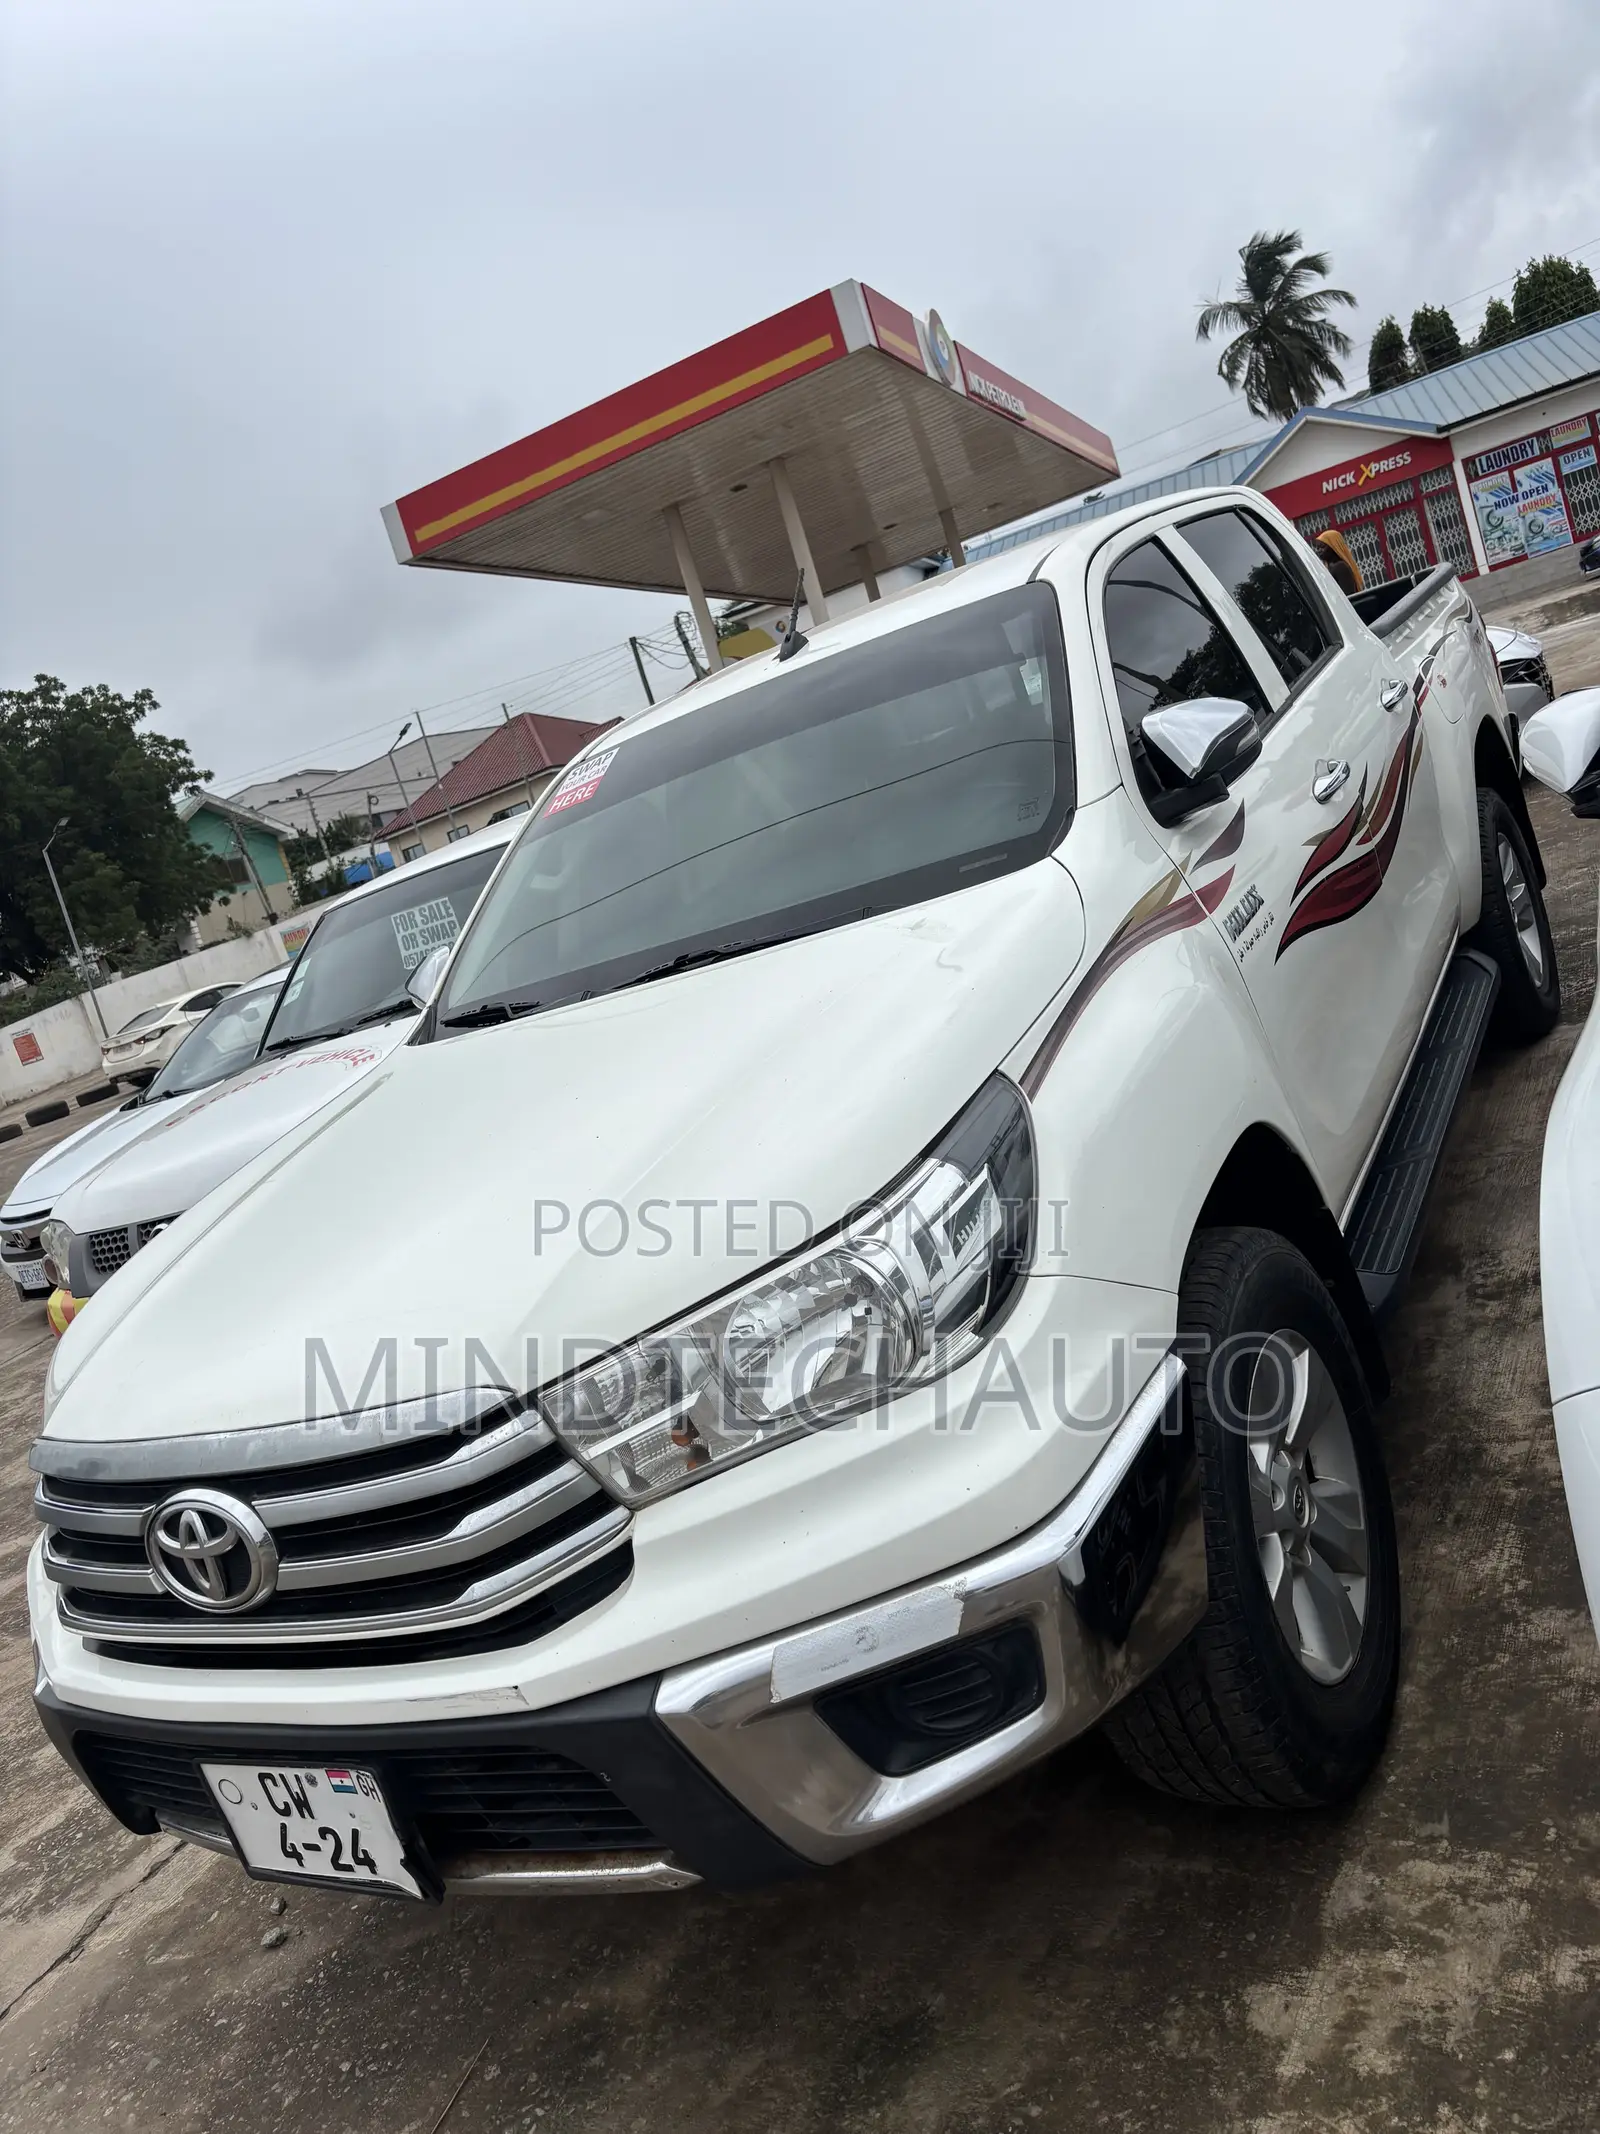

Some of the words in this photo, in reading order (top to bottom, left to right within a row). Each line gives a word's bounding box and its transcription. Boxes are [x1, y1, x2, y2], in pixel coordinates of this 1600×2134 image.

[1551, 417, 1587, 437] LAUNDRY
[1478, 439, 1536, 474] LAUNDRY
[1563, 448, 1591, 465] OPEN
[1322, 471, 1356, 494] NICK
[1357, 451, 1412, 487] XPRESS
[1494, 493, 1519, 511] NOW
[1522, 483, 1549, 501] OPEN
[1516, 494, 1558, 513] LAUNDRY
[561, 775, 587, 791] YOUR
[587, 765, 607, 781] CAR
[568, 752, 614, 781] SWAP
[549, 782, 598, 813] HERE
[393, 911, 419, 934] FOR
[418, 900, 454, 926] SALE
[401, 932, 419, 951] OR
[419, 920, 458, 946] SWAP
[295, 1048, 376, 1068] VEHICLE
[258, 1771, 316, 1820] CW
[355, 1774, 382, 1804] GH
[279, 1822, 378, 1875] 4-24
